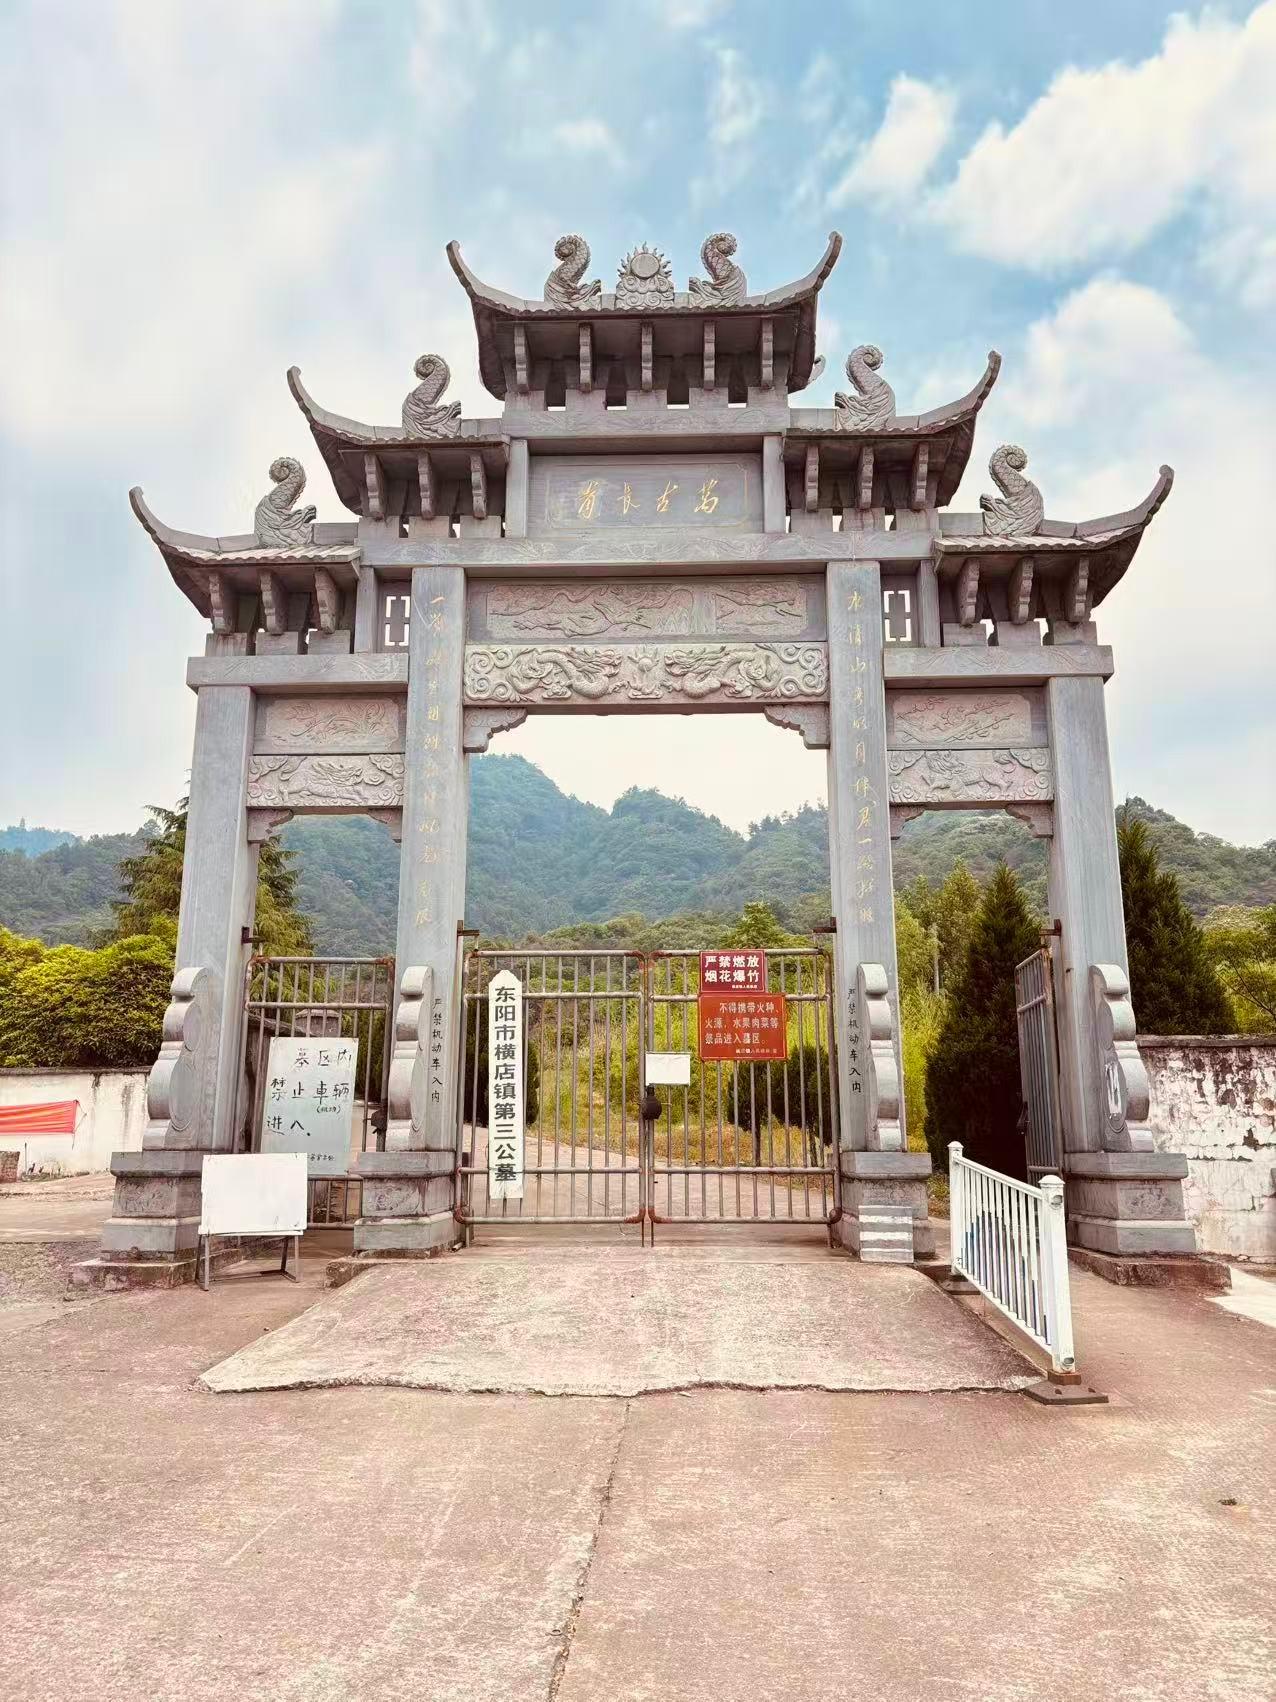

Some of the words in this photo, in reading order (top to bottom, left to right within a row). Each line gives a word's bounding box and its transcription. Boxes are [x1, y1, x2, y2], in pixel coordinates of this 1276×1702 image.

[704, 955, 760, 968] 严禁燃放
[704, 970, 760, 983] 烟花爆竹
[295, 1047, 352, 1068] 墓区内
[431, 998, 443, 1103] 严禁机动车入内
[847, 988, 862, 1093] 严禁机动车入内
[494, 986, 516, 1182] 东阳市横店镇第三公墓
